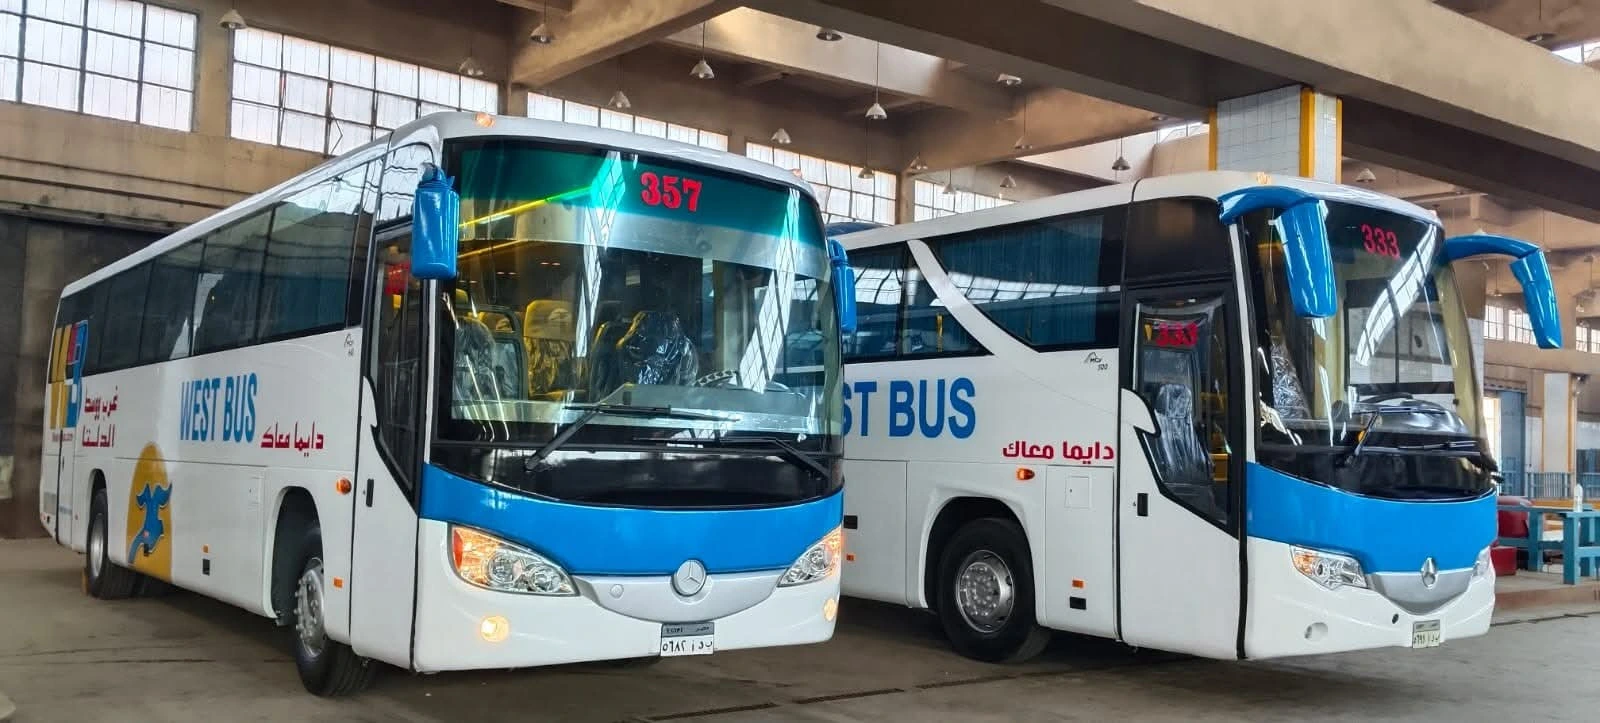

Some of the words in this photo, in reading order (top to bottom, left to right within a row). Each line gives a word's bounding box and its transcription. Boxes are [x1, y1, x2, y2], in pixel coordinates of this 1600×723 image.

[641, 172, 702, 212] 357
[1361, 223, 1400, 260] 333
[180, 378, 221, 442] WEST
[222, 372, 258, 443] BUS
[889, 377, 976, 439] BUS
[82, 424, 115, 447] الدلتا
[261, 420, 291, 449] معاك
[294, 420, 324, 457] دايما
[1003, 440, 1054, 459] معاك
[1063, 441, 1114, 464] دايما
